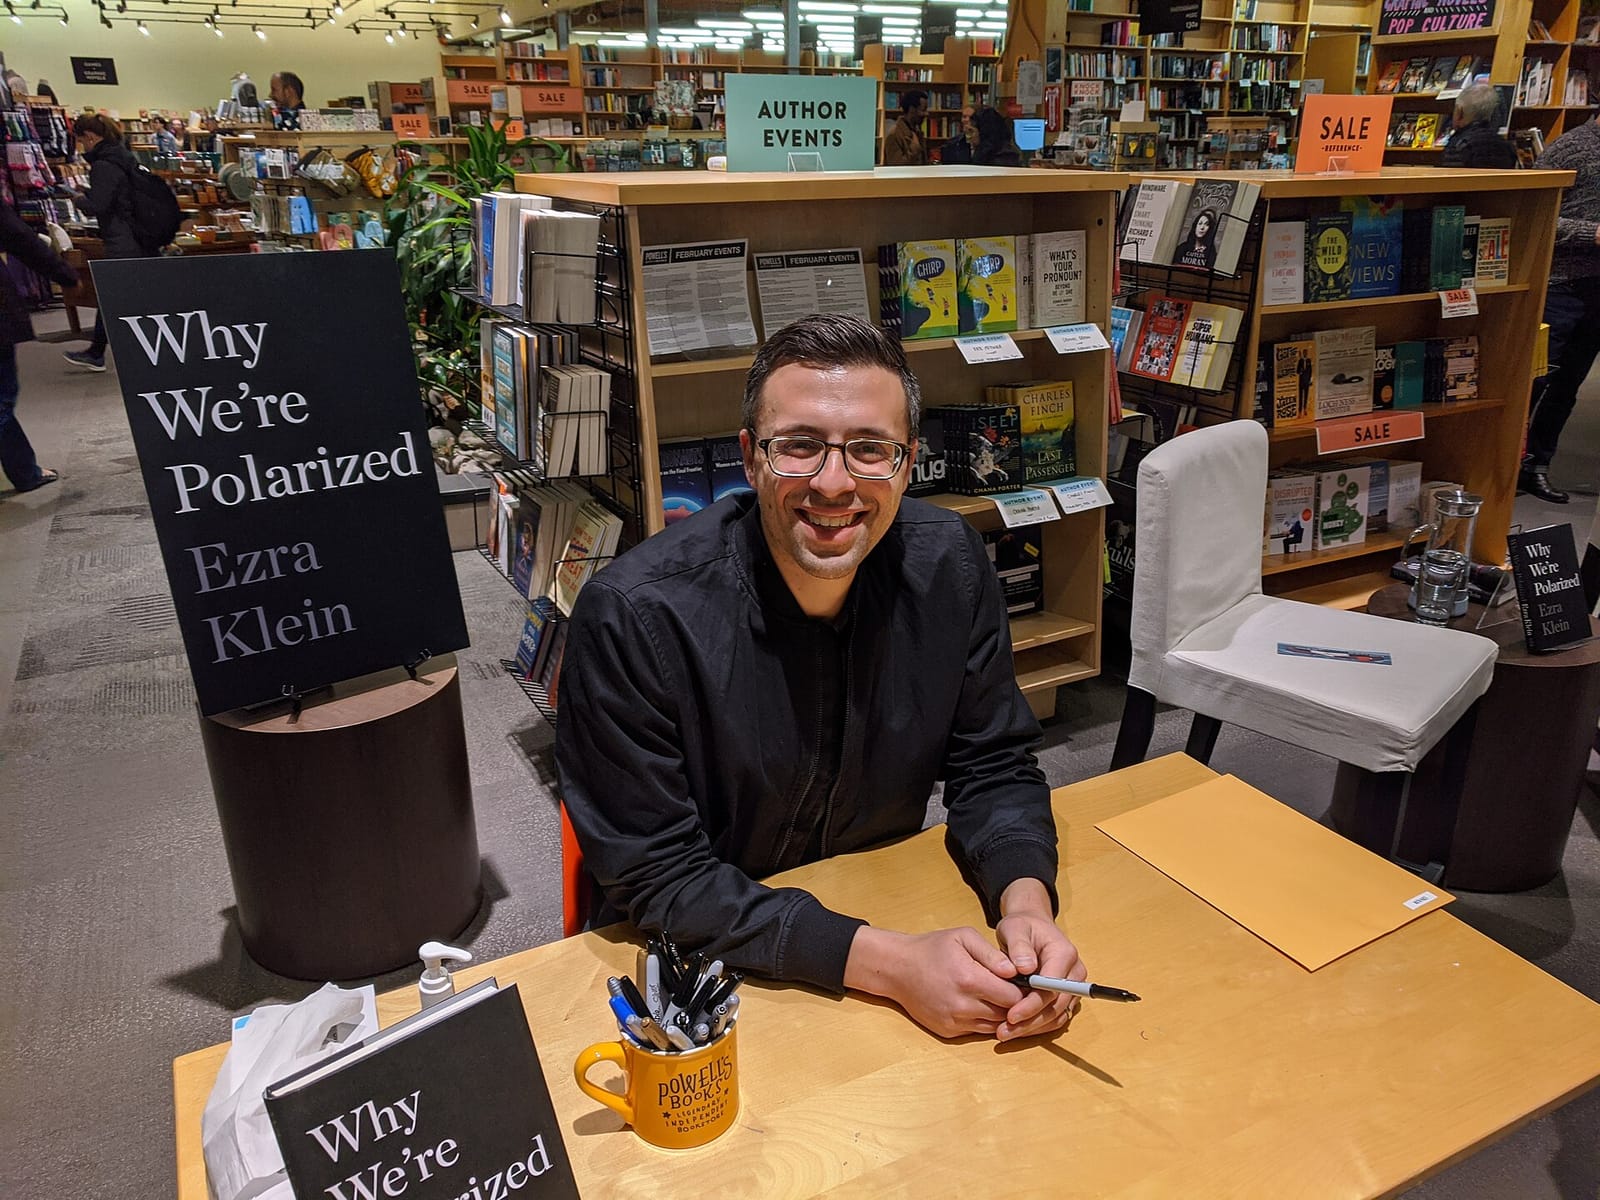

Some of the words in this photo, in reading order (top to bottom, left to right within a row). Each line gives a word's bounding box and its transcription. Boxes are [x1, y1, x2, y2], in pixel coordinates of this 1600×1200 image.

[1388, 18, 1415, 34] POP
[1421, 12, 1487, 33] CULTURE
[463, 85, 489, 94] SALE
[538, 93, 565, 102] SALE
[757, 101, 847, 120] AUTHOR
[400, 120, 422, 128] SALE
[1320, 116, 1371, 140] SALE
[763, 129, 843, 148] EVENTS
[675, 248, 713, 259] FEBRUARY
[714, 246, 741, 256] EVENTS
[1049, 249, 1077, 261] WHAT'S
[1321, 245, 1342, 255] WILD
[1354, 242, 1390, 259] NEW
[790, 255, 828, 264] FEBRUARY
[829, 254, 856, 262] EVENTS
[1053, 261, 1073, 271] YOUR
[1181, 256, 1207, 266] MORAN
[917, 260, 942, 277] CHIRP
[1043, 270, 1082, 283] PRONOUN?
[1447, 292, 1469, 301] SALE
[1192, 322, 1212, 333] SUPER
[118, 309, 269, 369] Why
[1023, 389, 1071, 405] CHARLES
[137, 382, 310, 441] We're
[1031, 402, 1064, 416] FINCH
[978, 414, 1018, 429] SEEP
[1354, 423, 1391, 442] SALE
[1038, 449, 1062, 465] LAST
[164, 431, 423, 515] Polarized
[1025, 463, 1075, 480] PASSENGER
[1026, 494, 1044, 502] EVENT
[1274, 486, 1313, 499] DISRUPTED
[1109, 545, 1136, 570] ulls
[1525, 543, 1552, 558] Why
[184, 540, 323, 595] Ezra
[1528, 561, 1560, 577] We're
[1534, 573, 1581, 596] Polarized
[1538, 602, 1563, 617] Ezra
[202, 598, 358, 664] Klein
[1541, 619, 1570, 636] Klein
[658, 1056, 733, 1106] POWELL'S
[669, 1078, 723, 1109] BOOKS
[665, 1100, 728, 1127] INDEPENDENT
[676, 1097, 721, 1118] LEGENDARY
[305, 1090, 422, 1163] Why
[677, 1111, 723, 1133] BOOKSTORE
[323, 1138, 460, 1200] We're
